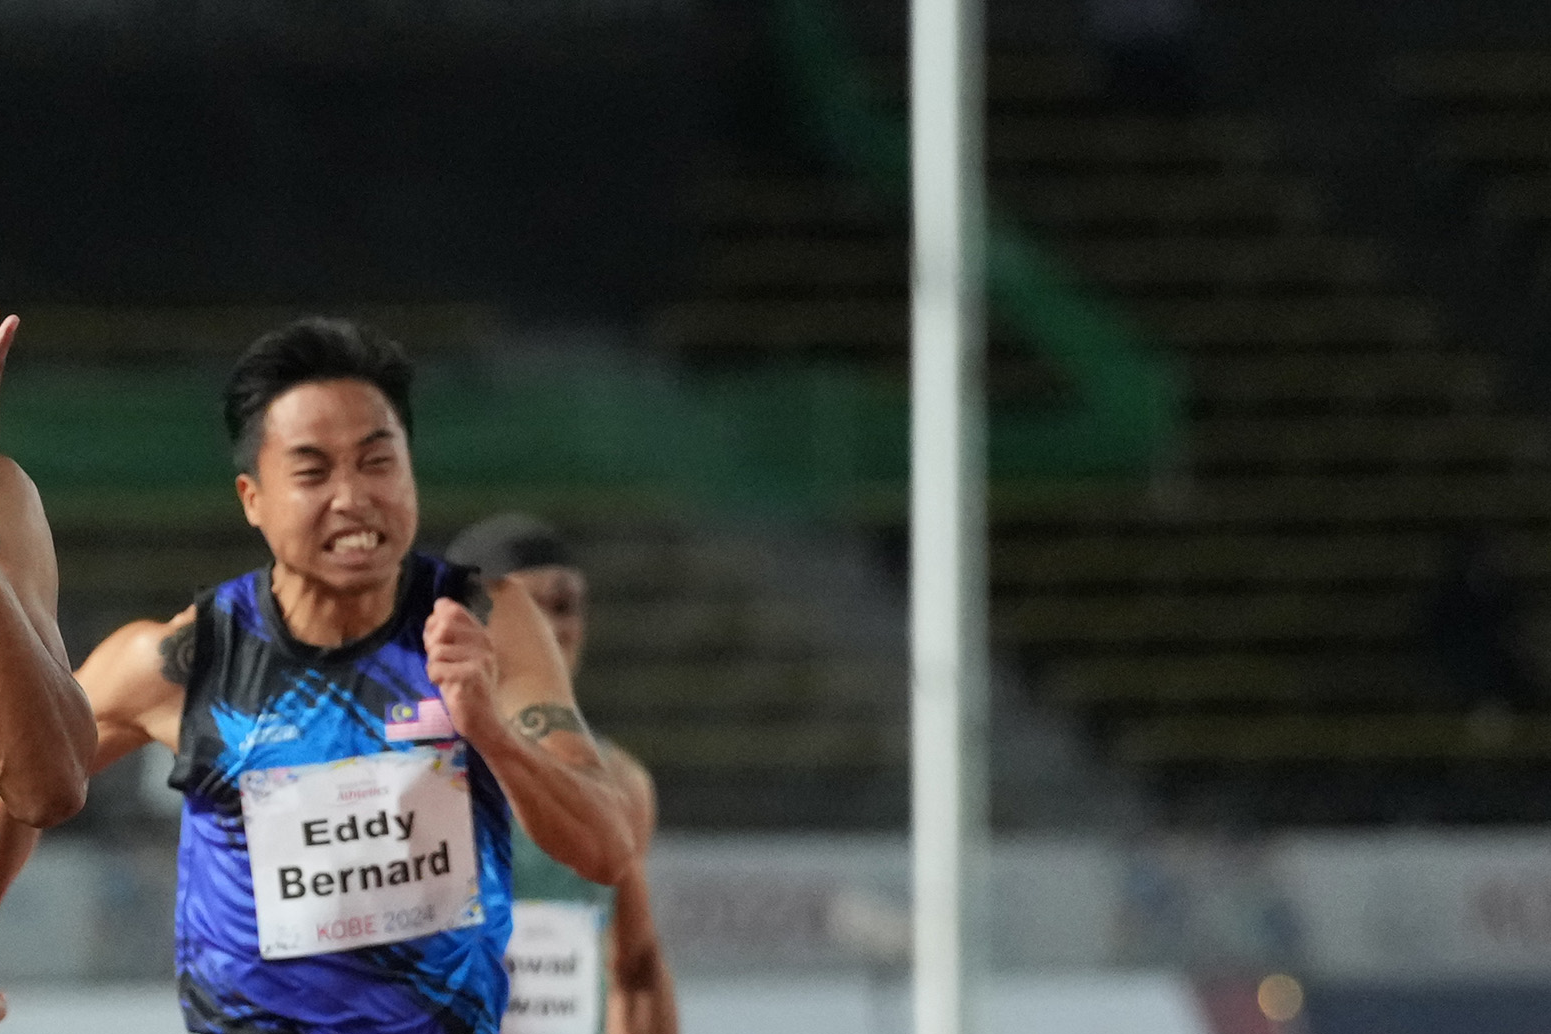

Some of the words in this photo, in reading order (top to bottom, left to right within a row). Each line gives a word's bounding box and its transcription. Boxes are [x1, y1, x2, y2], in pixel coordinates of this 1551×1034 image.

[302, 810, 416, 847] Eddy
[278, 841, 451, 900] Bernard
[316, 914, 378, 942] KOBE
[383, 904, 437, 934] 2024
